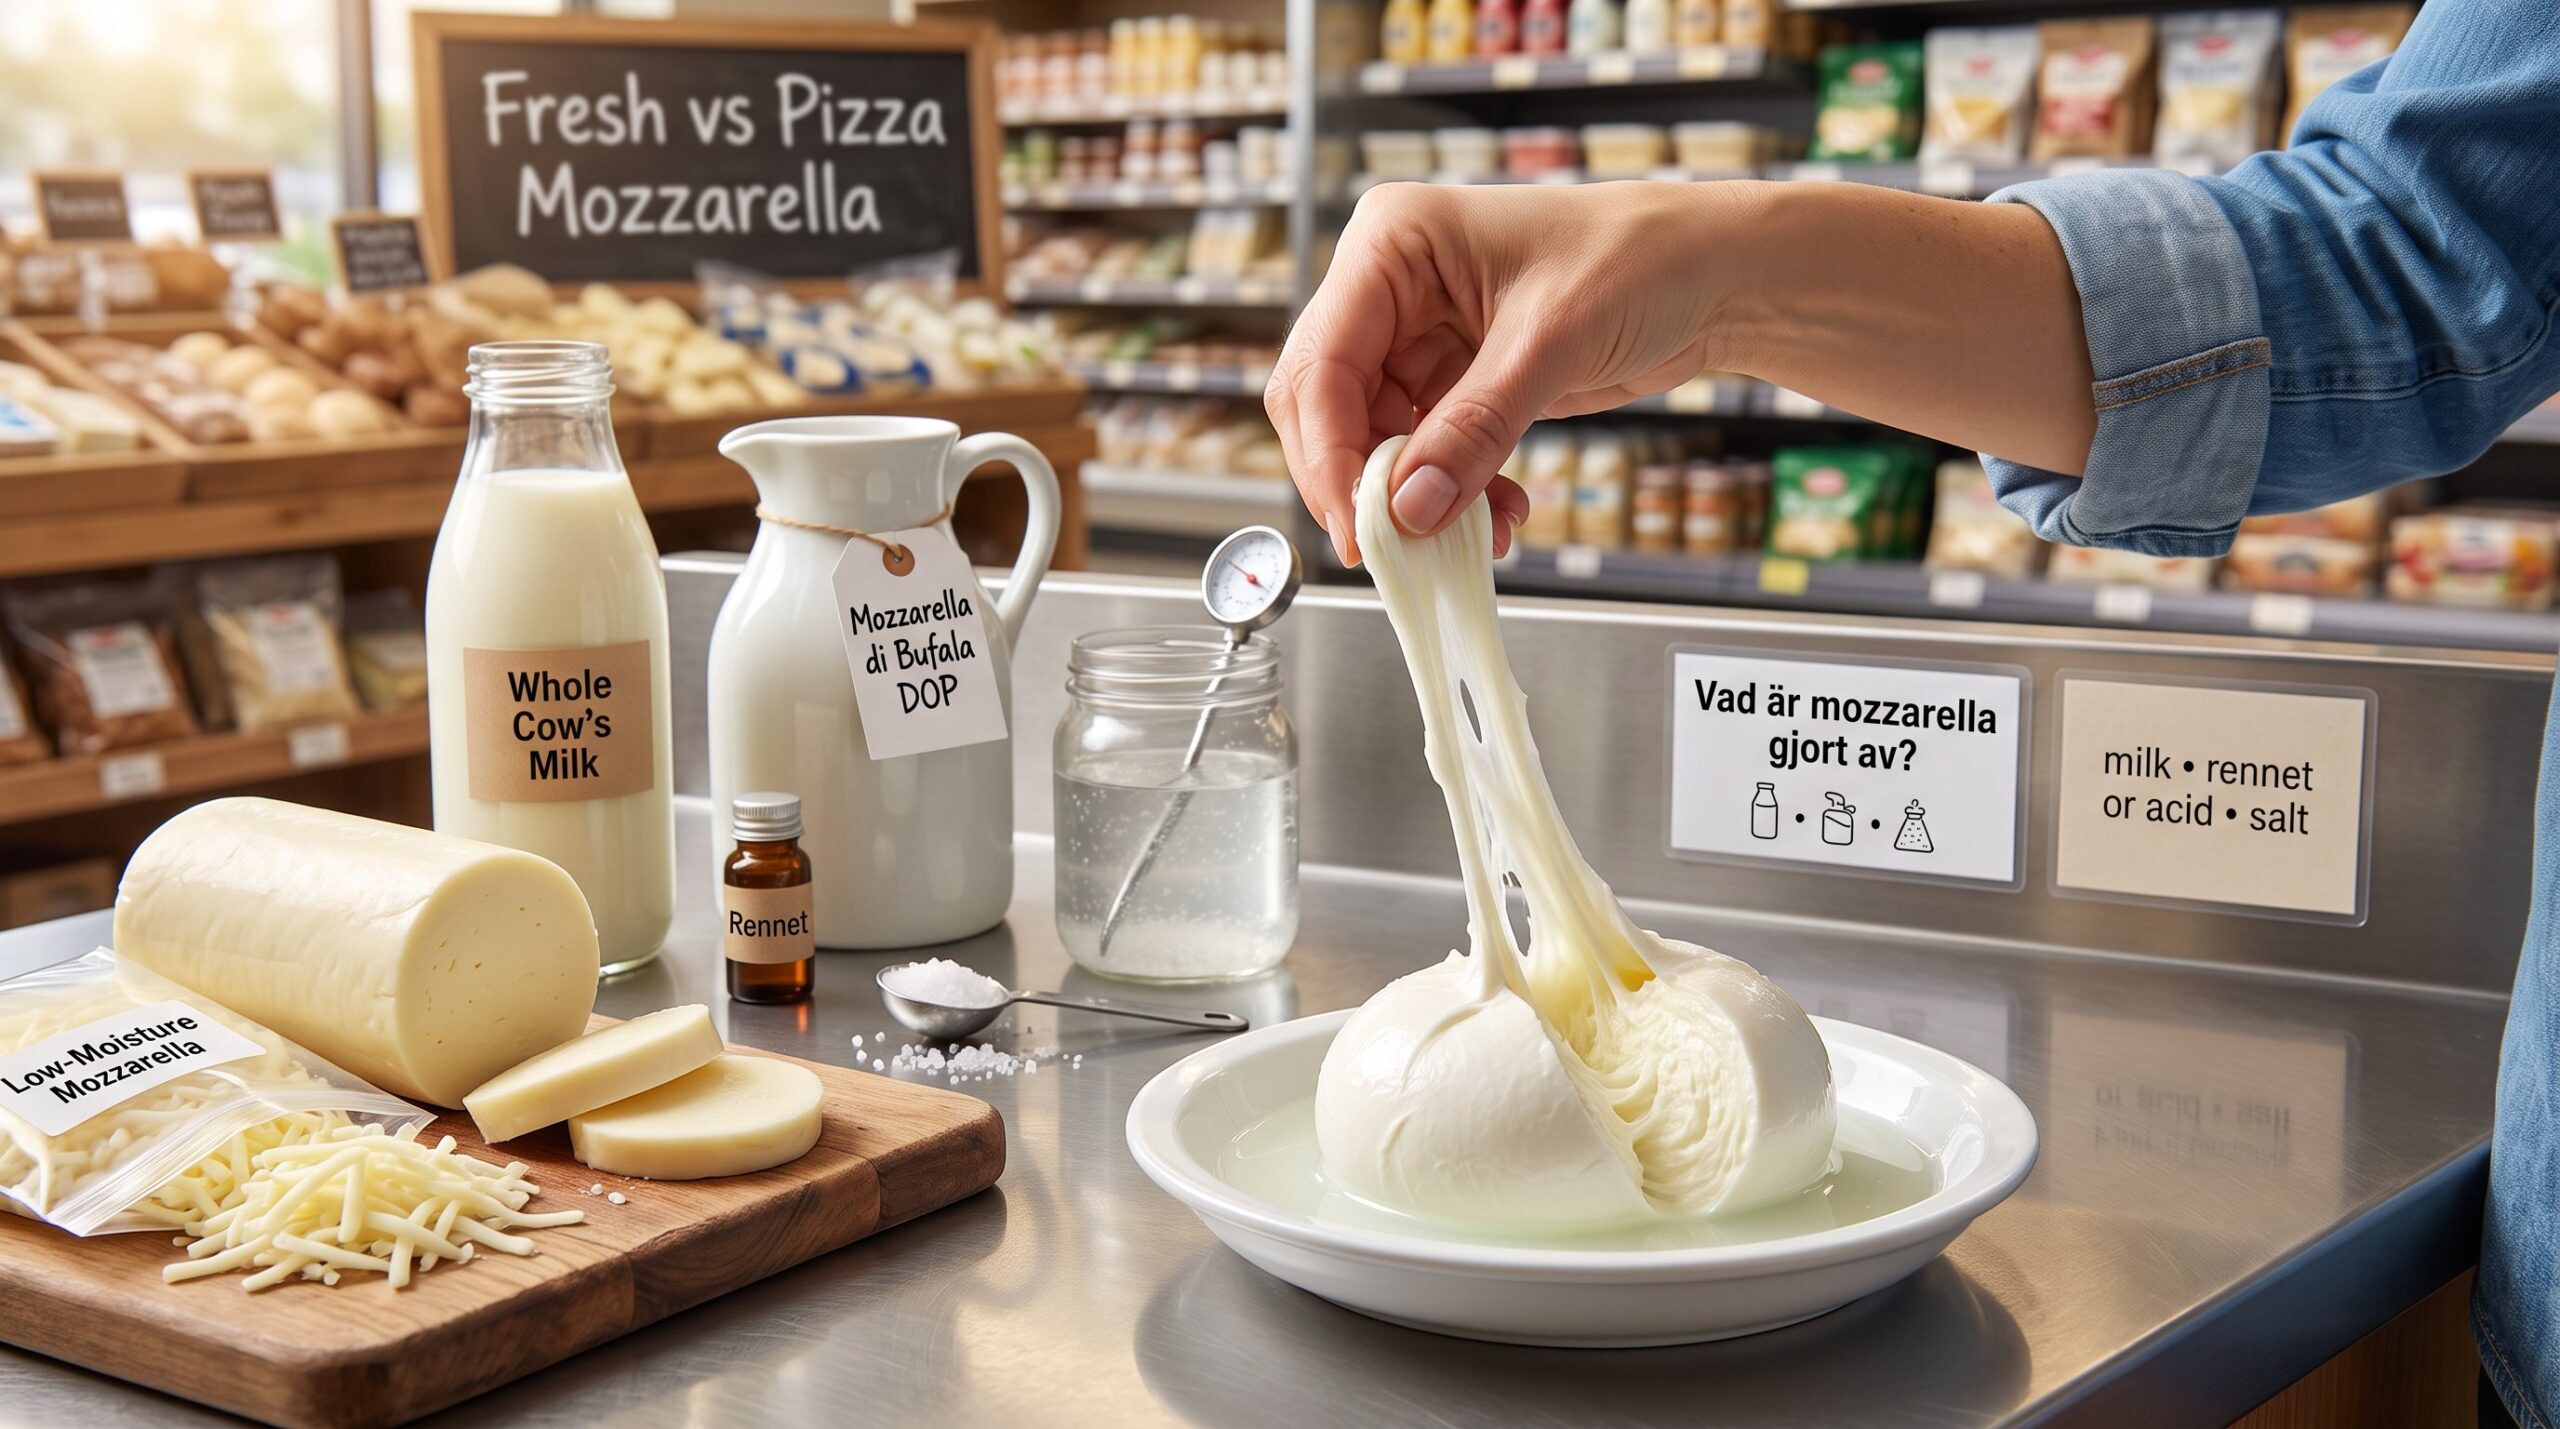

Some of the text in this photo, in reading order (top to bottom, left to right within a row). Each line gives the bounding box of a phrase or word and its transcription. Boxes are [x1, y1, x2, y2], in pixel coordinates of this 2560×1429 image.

[482, 71, 947, 147] Fresh vs Pizza
[518, 160, 882, 238] Mozzarella
[850, 588, 973, 635] Mozzarella
[866, 629, 976, 674] di Bufala
[507, 668, 612, 702] Whole
[897, 674, 958, 714] DOP
[1694, 679, 1998, 735] Vad är mozzarella
[513, 708, 611, 741] Cow's
[530, 747, 600, 780] Milk
[1768, 729, 1917, 771] gjort av?
[2103, 746, 2172, 780] milk
[2206, 757, 2314, 791] rennet
[2102, 794, 2136, 820] or
[2145, 794, 2214, 827] acid
[2249, 803, 2310, 835] salt
[730, 910, 808, 937] Rennet
[0, 1016, 199, 1094] Low-Moisture
[49, 1041, 207, 1103] Mozzarella
